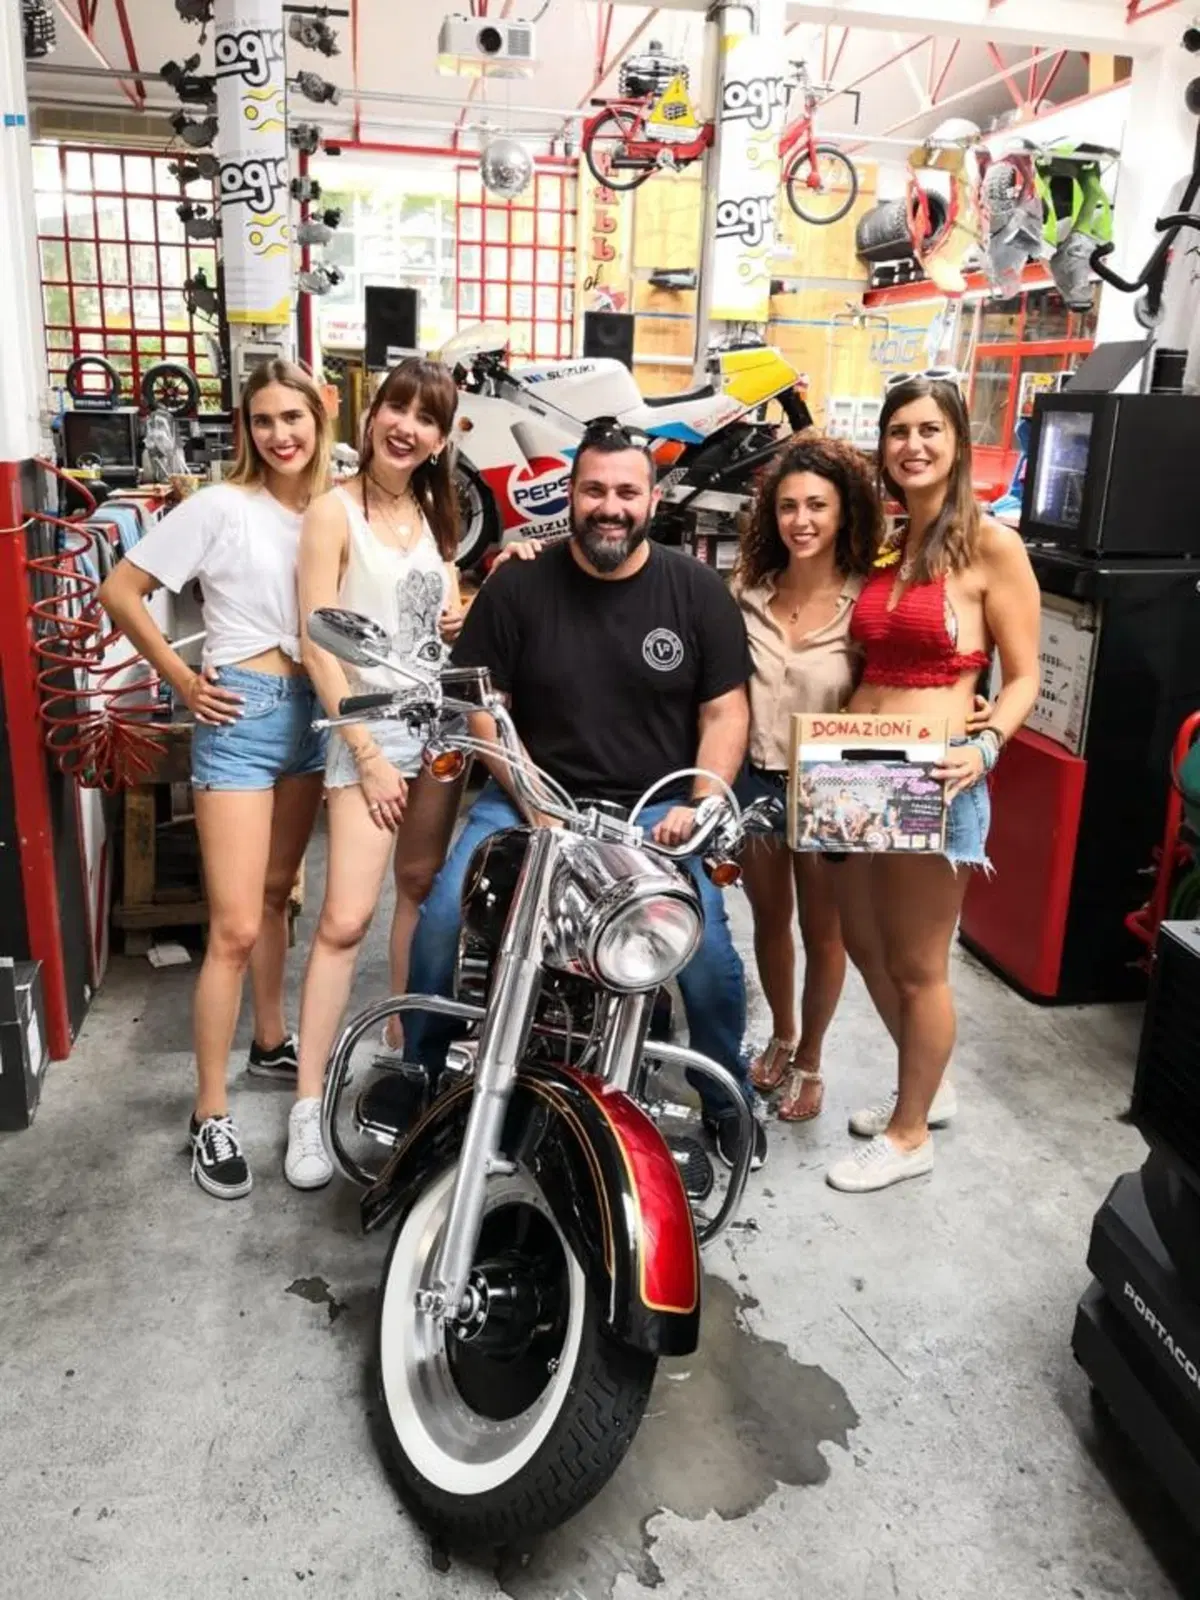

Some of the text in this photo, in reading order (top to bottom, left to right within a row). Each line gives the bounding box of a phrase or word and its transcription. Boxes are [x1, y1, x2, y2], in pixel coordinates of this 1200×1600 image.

[513, 473, 573, 505] PEPS
[519, 518, 568, 538] SUZU
[1124, 1281, 1200, 1390] PORTACO
